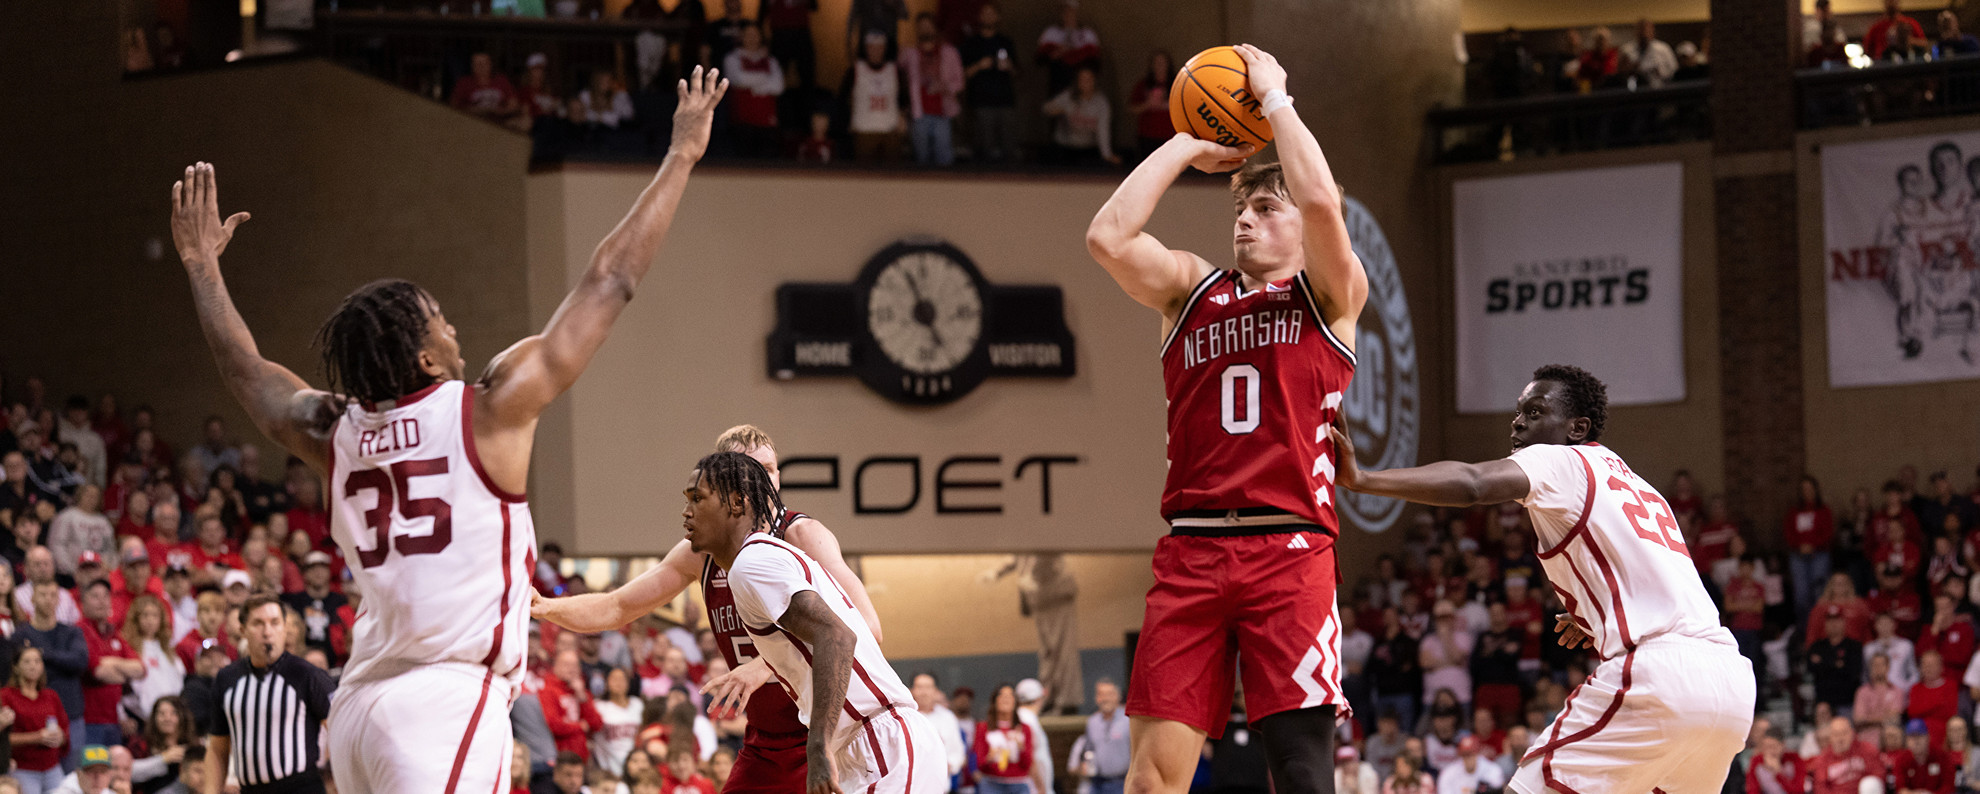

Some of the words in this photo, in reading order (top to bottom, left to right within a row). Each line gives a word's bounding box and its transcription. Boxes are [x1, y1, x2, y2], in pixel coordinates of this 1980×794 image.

[1197, 102, 1253, 147] ilson
[1486, 267, 1649, 313] SPORTS
[795, 342, 850, 366] HOME
[989, 344, 1062, 367] VISITOR
[1184, 310, 1303, 370] NEBRASKA
[1221, 363, 1261, 435] 0
[359, 418, 421, 458] REID
[344, 456, 452, 569] 35
[1607, 475, 1692, 560] 22
